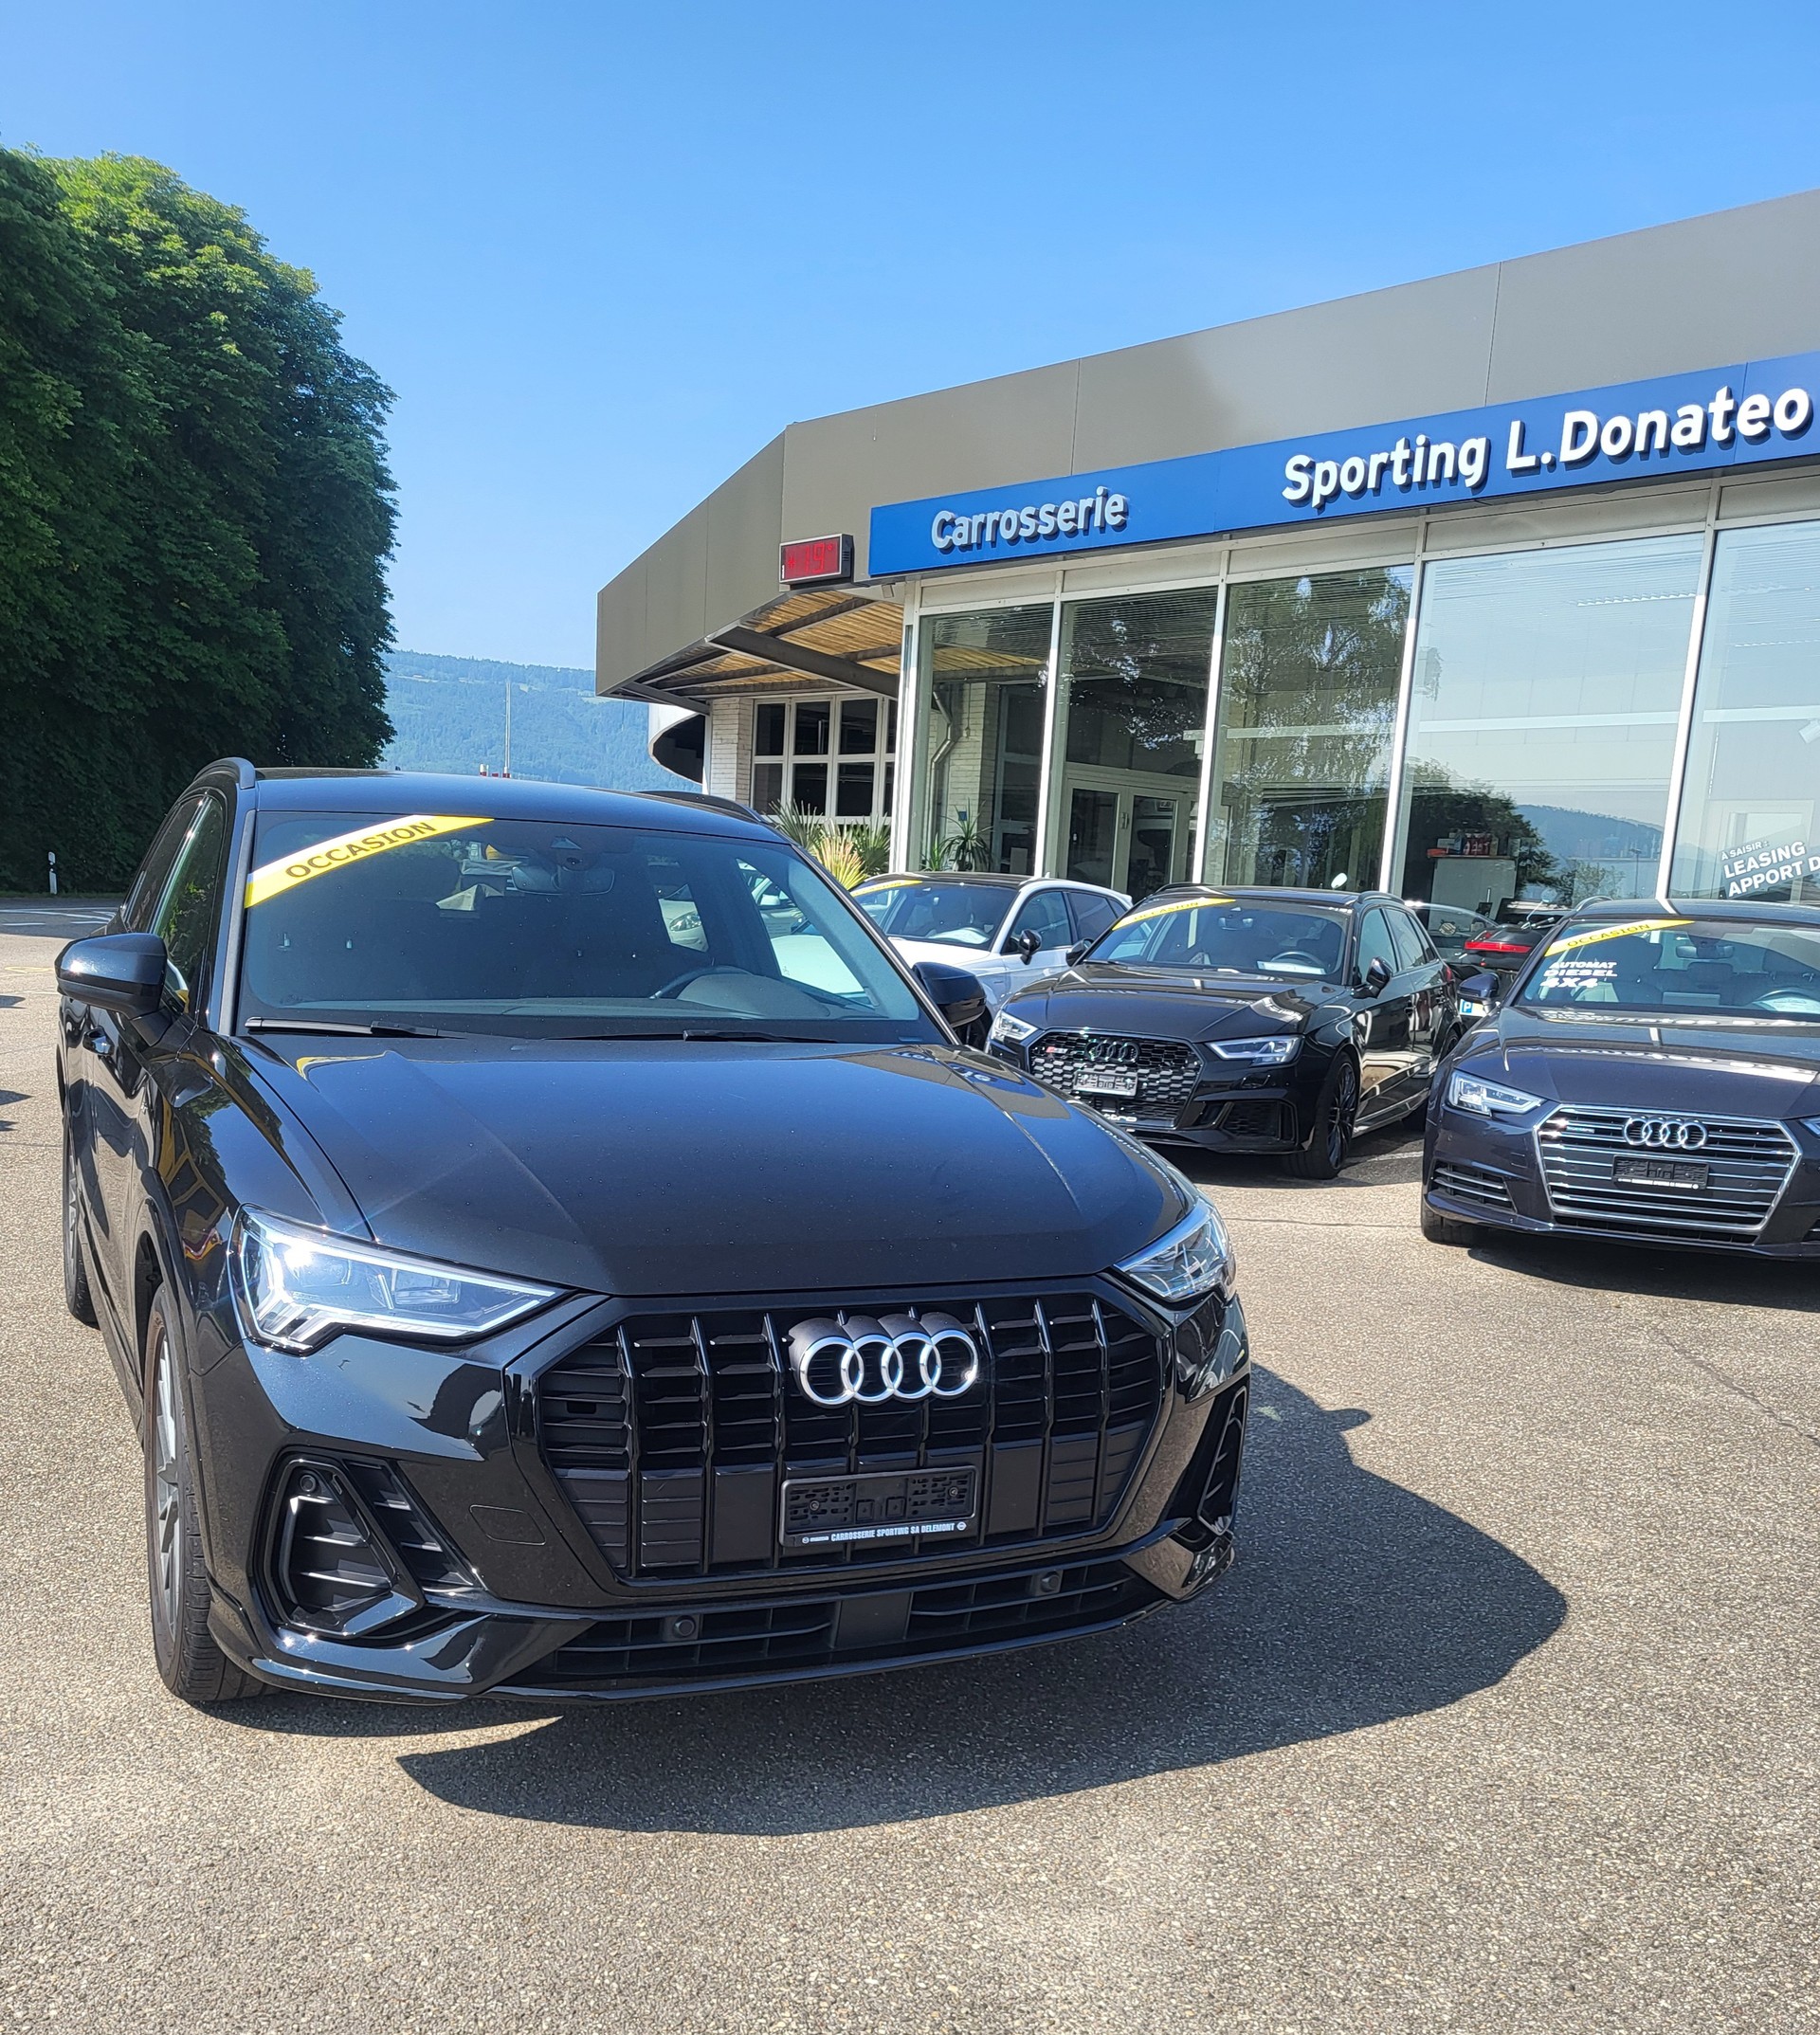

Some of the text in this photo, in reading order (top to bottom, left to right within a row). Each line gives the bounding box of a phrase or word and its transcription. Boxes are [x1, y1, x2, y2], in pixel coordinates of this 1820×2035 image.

[932, 485, 1127, 550] Carrosserie
[1282, 433, 1486, 509] Sporting
[285, 821, 438, 879] OCCASION
[1723, 841, 1806, 879] LEASING
[1729, 841, 1762, 858] SAISIR
[1728, 861, 1804, 898] APPORT
[1567, 923, 1650, 948] OCCASION
[1543, 969, 1618, 977] DIESEL
[1548, 961, 1617, 970] AUTOMAT
[1539, 977, 1598, 989] 4X4
[830, 1529, 876, 1542] CARROSSERIE
[876, 1526, 909, 1537] SPORTING
[910, 1525, 920, 1535] SA
[920, 1522, 956, 1534] DELEMONT
